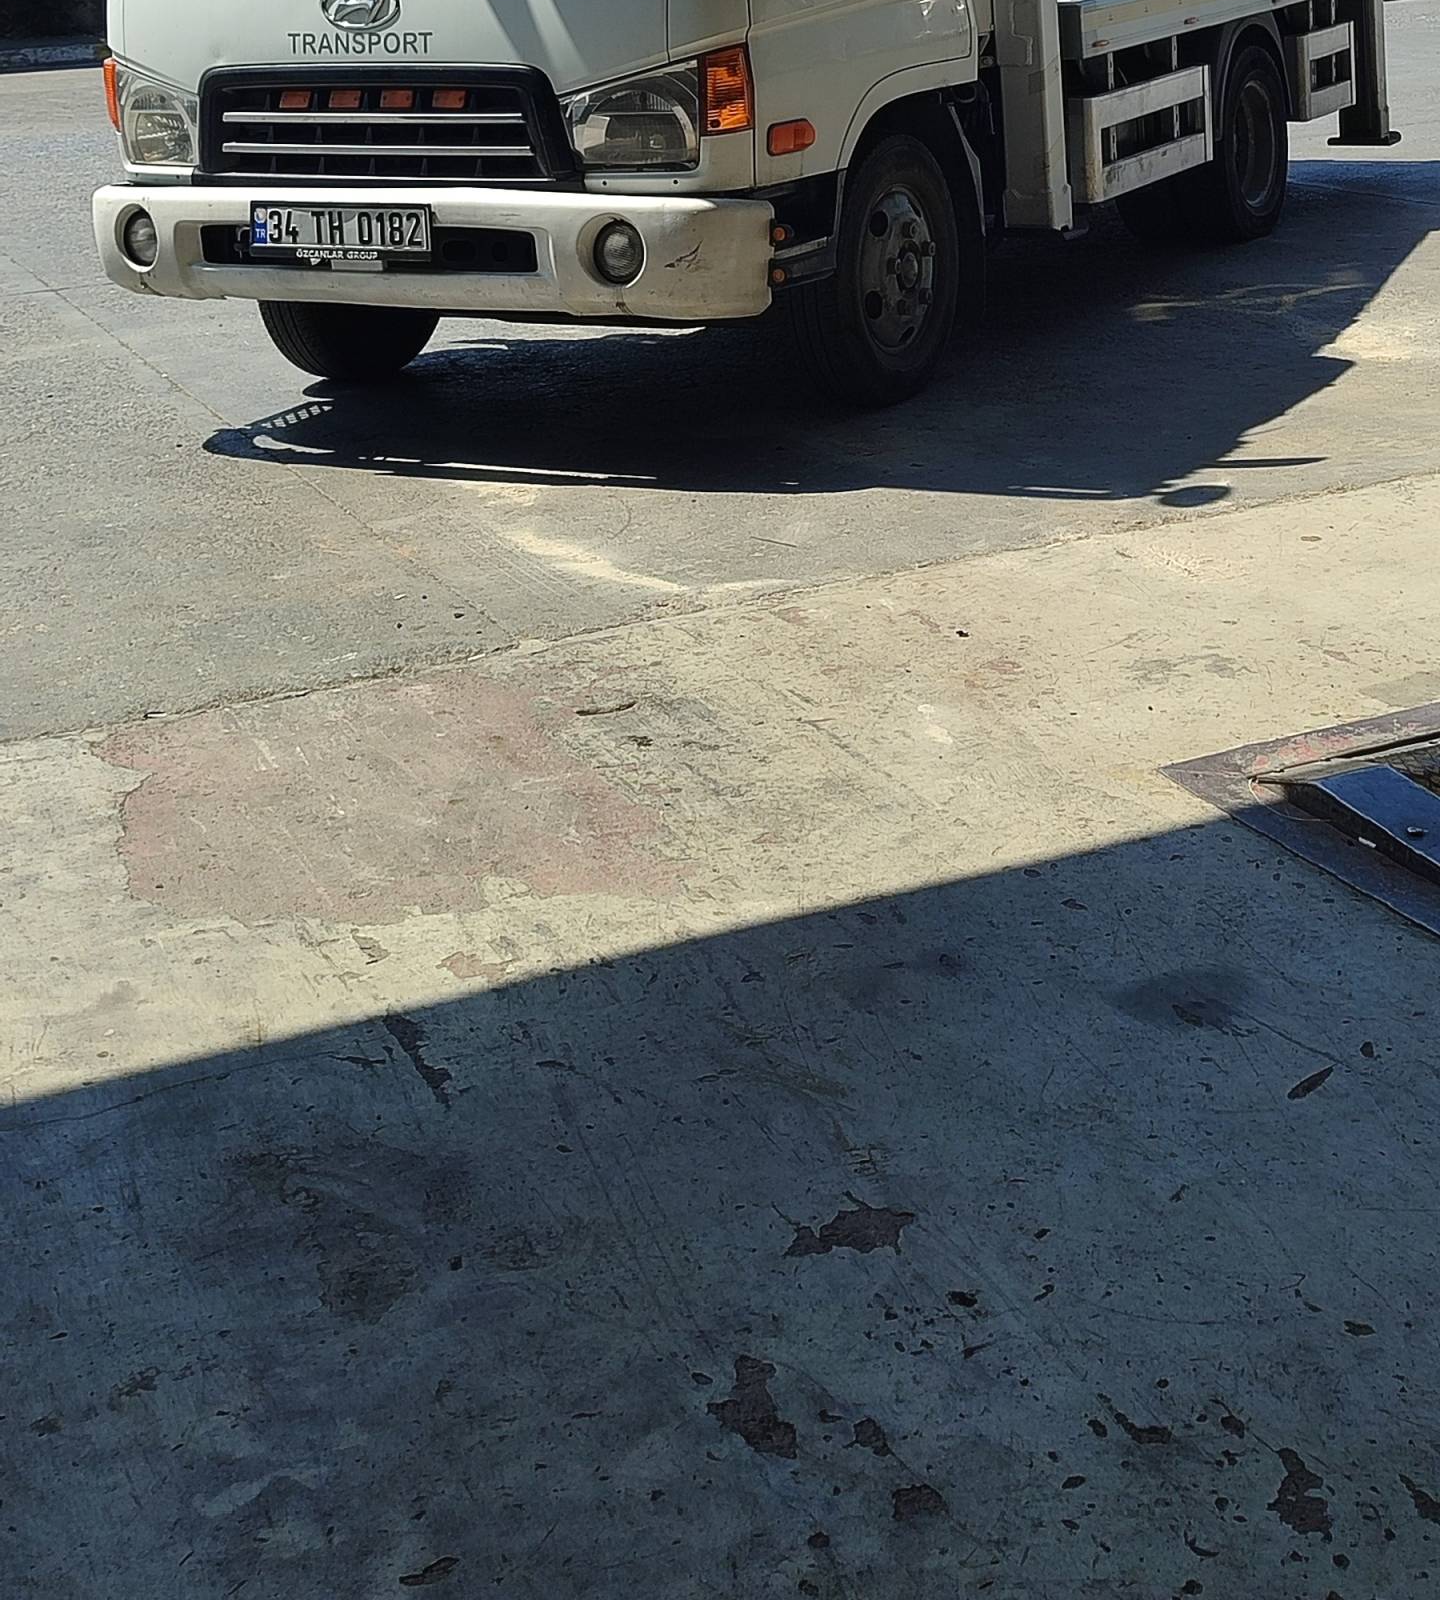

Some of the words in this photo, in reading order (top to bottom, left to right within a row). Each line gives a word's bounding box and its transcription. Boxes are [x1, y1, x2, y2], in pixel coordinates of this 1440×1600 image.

[287, 31, 433, 55] TRANSPORT
[268, 209, 299, 245] 34
[310, 211, 345, 246] TH
[357, 211, 423, 247] 0182
[346, 251, 378, 261] GROUP
